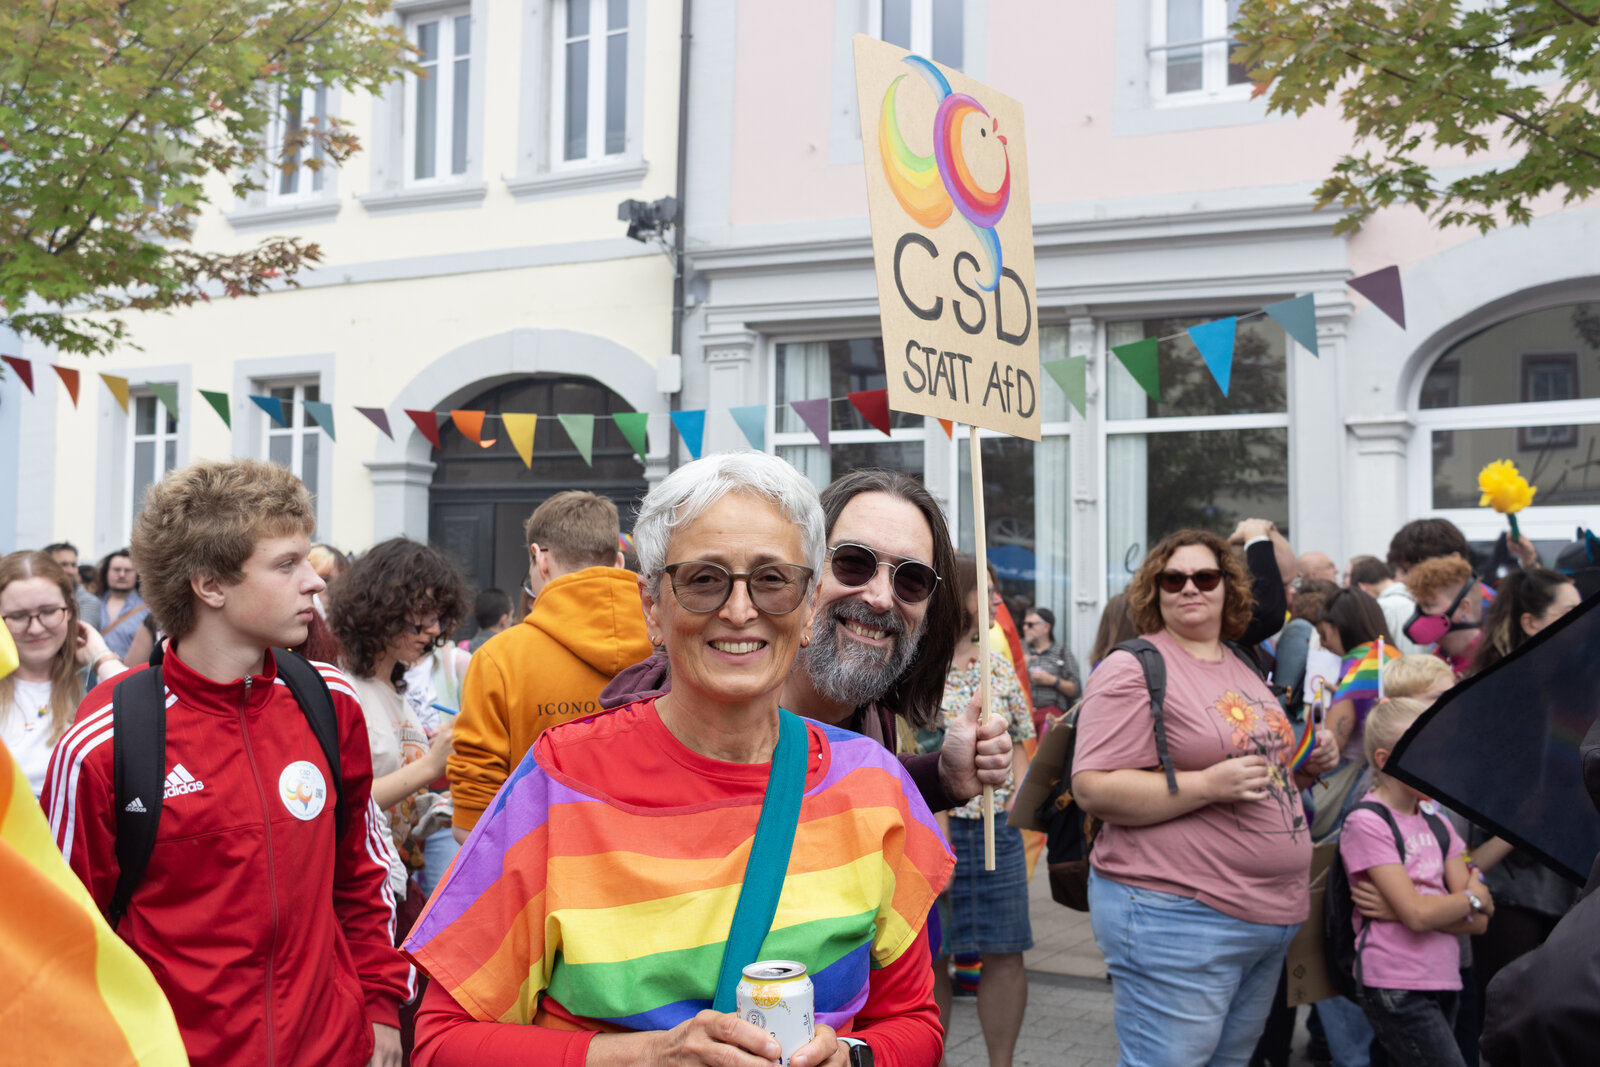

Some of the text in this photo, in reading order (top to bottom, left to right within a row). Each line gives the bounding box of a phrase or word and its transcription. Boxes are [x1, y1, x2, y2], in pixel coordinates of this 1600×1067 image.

[893, 232, 1032, 346] CSD
[902, 339, 1036, 419] STATT AfD
[537, 701, 596, 717] ICONO
